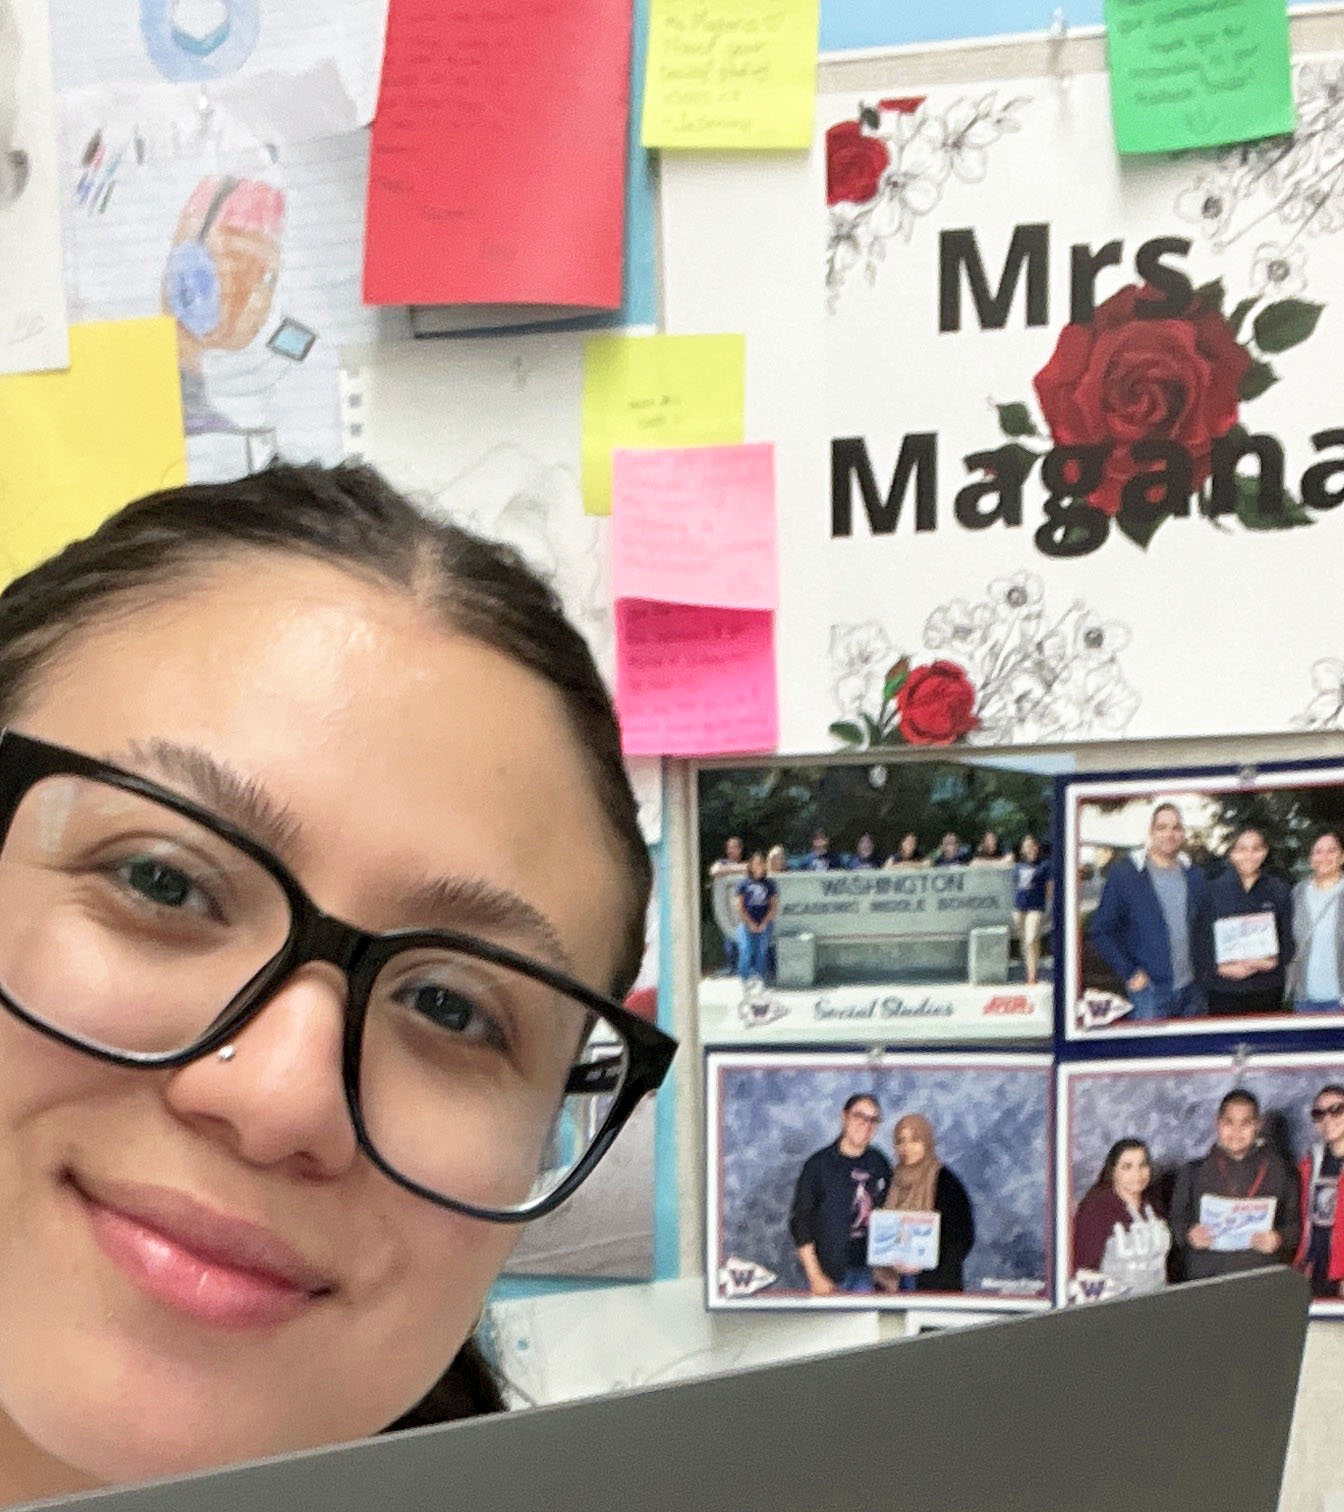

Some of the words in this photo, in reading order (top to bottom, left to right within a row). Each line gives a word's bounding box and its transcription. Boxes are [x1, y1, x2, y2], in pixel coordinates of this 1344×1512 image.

[938, 222, 1193, 333] Mrs
[821, 873, 965, 896] WASHINGTON
[814, 997, 875, 1020] Social
[880, 995, 954, 1018] Studies
[1080, 1279, 1106, 1298] W
